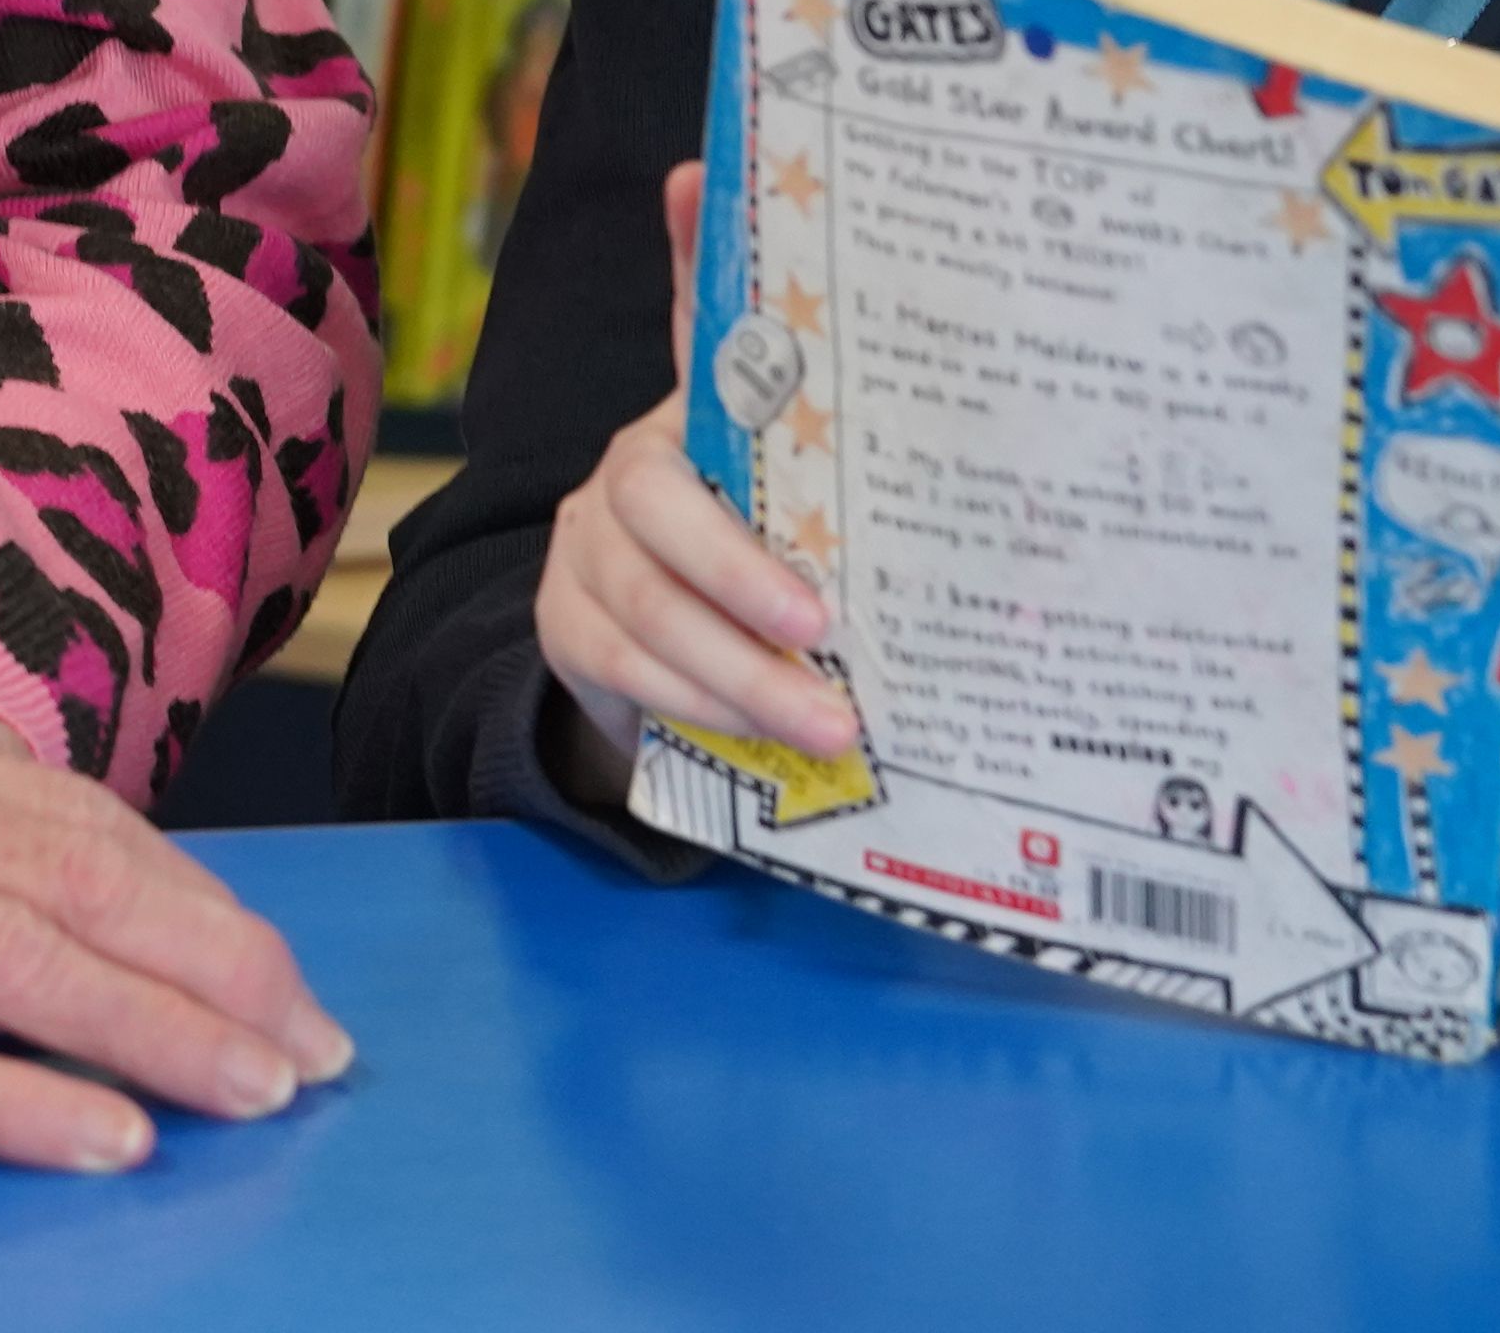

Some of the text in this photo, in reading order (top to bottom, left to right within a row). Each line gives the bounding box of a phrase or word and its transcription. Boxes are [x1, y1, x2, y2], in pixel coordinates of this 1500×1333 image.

[863, 0, 993, 46] GATES
[857, 66, 932, 106] Gold
[948, 83, 1028, 121] Star
[1046, 93, 1157, 146] Award
[1032, 155, 1108, 193] TOP
